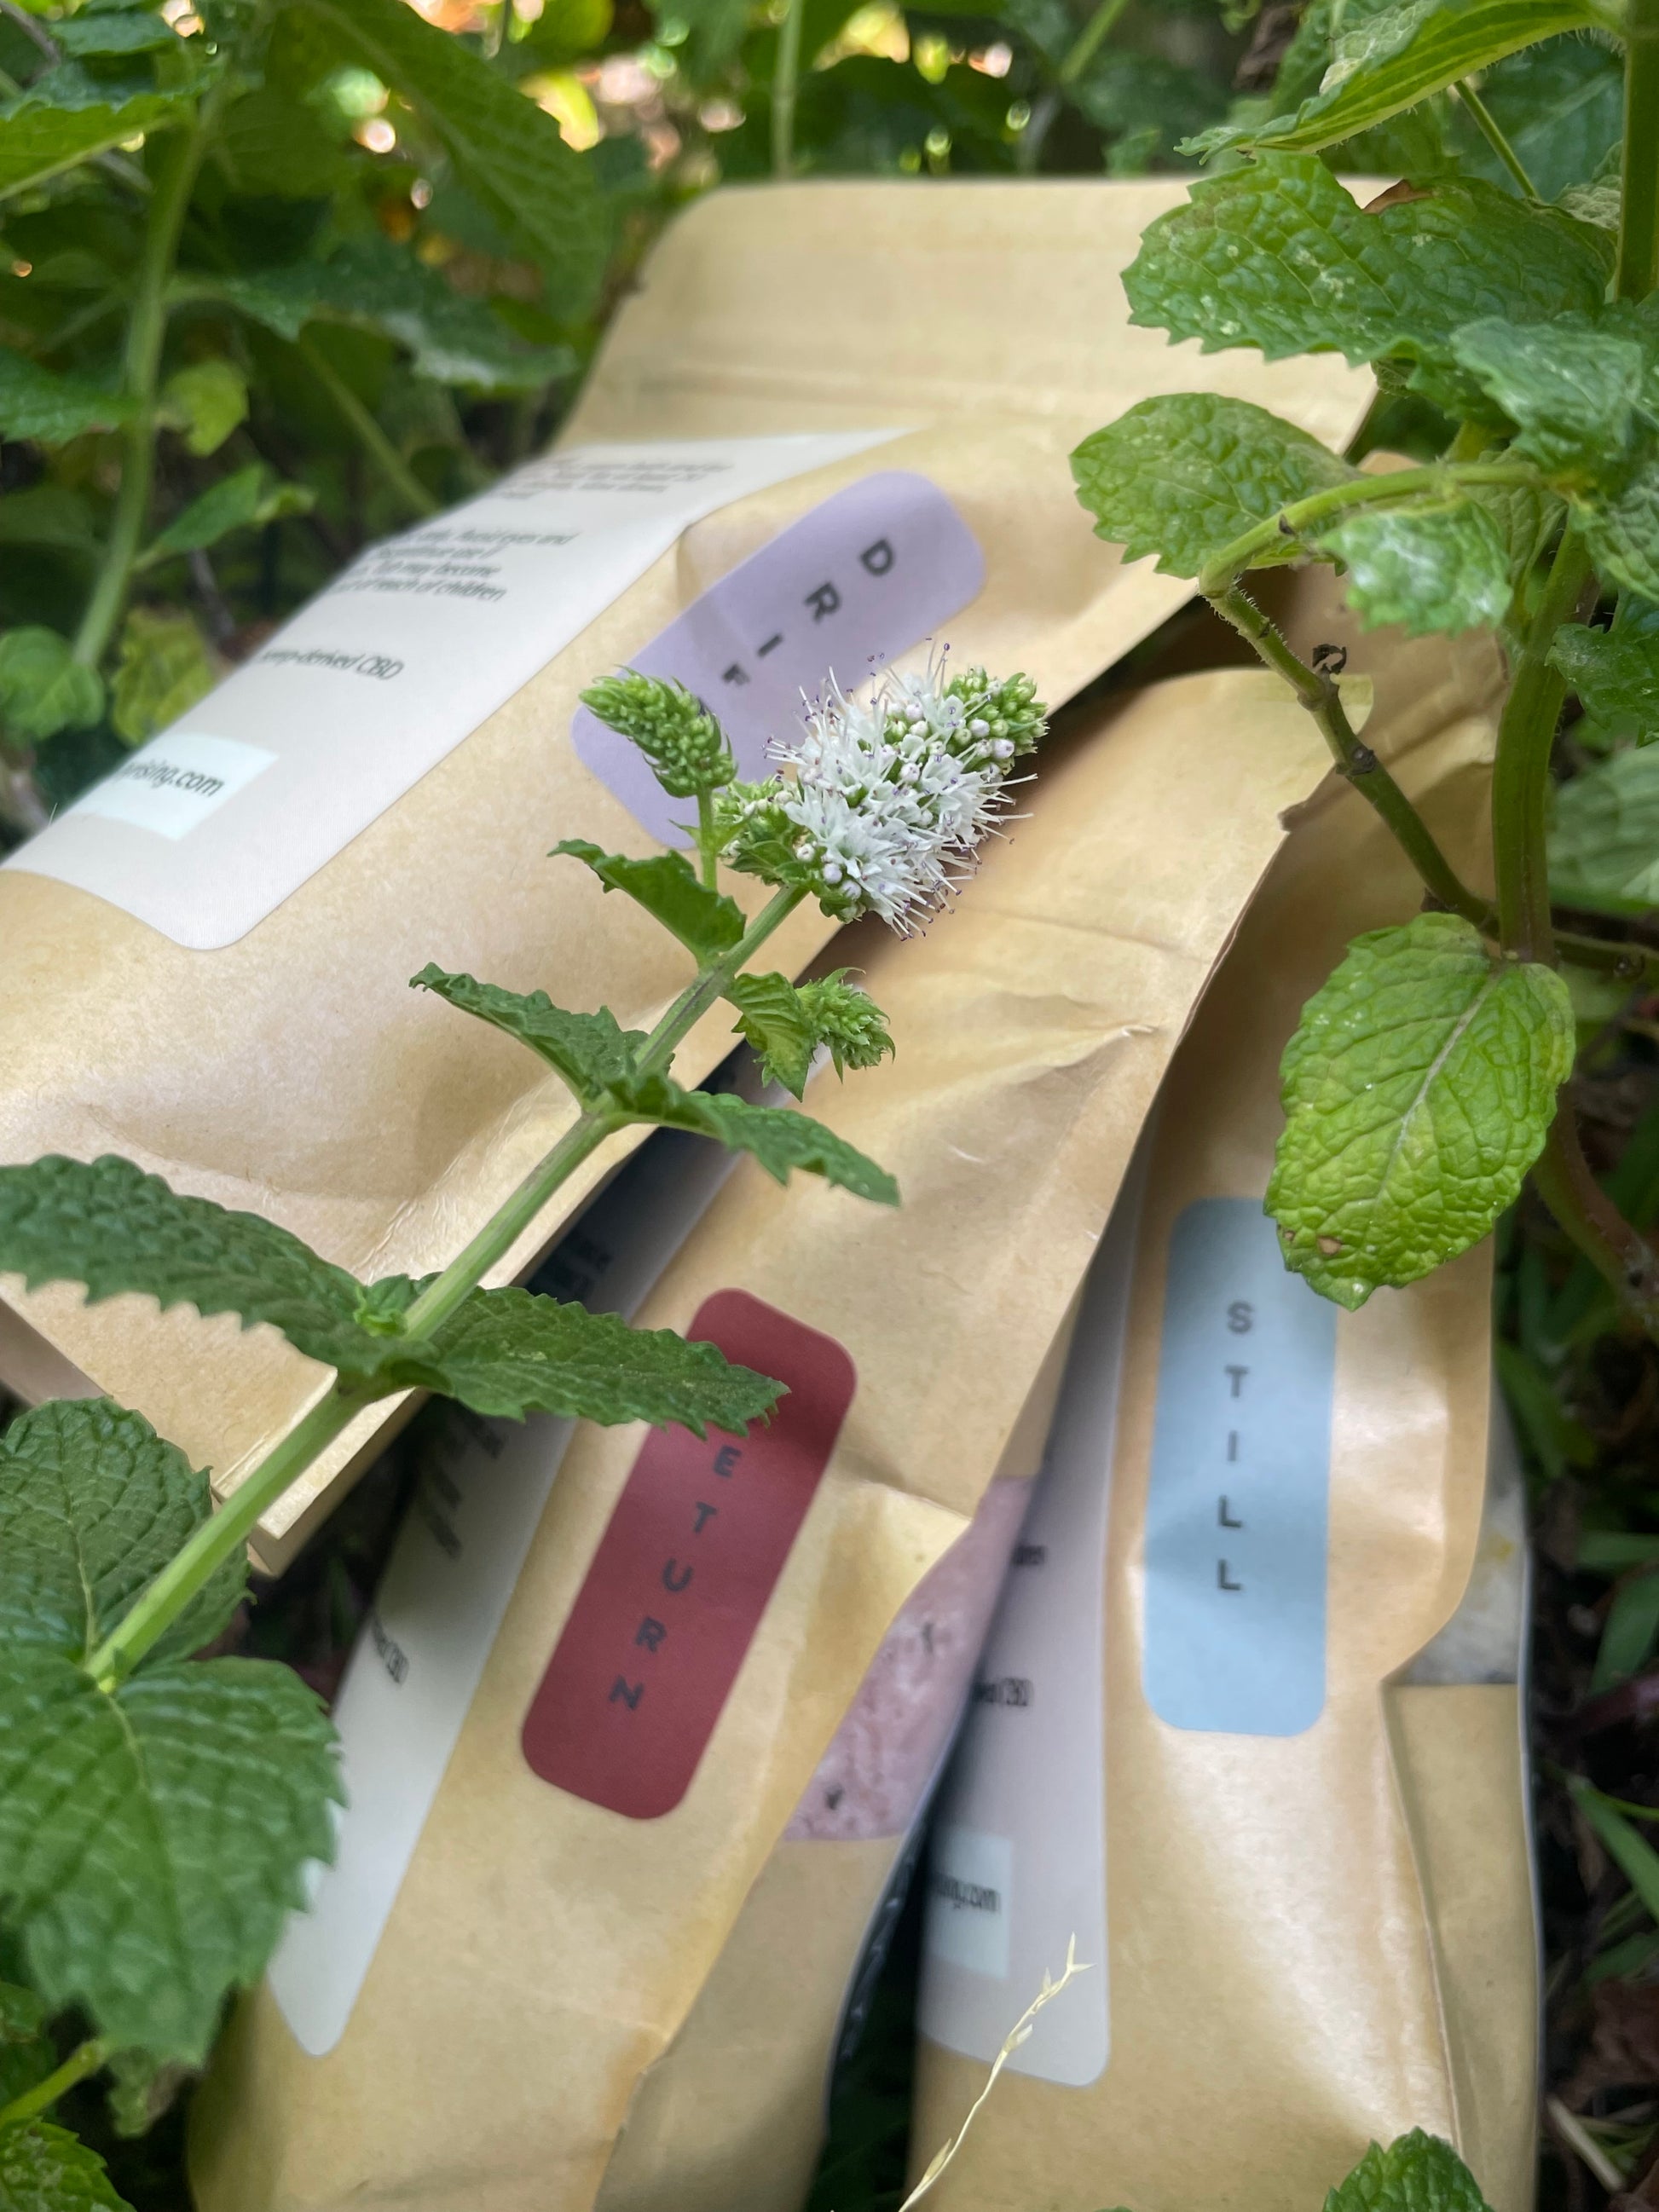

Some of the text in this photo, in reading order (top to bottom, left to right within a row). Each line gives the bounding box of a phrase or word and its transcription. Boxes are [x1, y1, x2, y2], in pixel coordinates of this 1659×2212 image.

[355, 655, 406, 680] CBD
[697, 539, 896, 716] DRIF
[1217, 1301, 1255, 1592] STILL
[610, 1444, 743, 1711] ETURN
